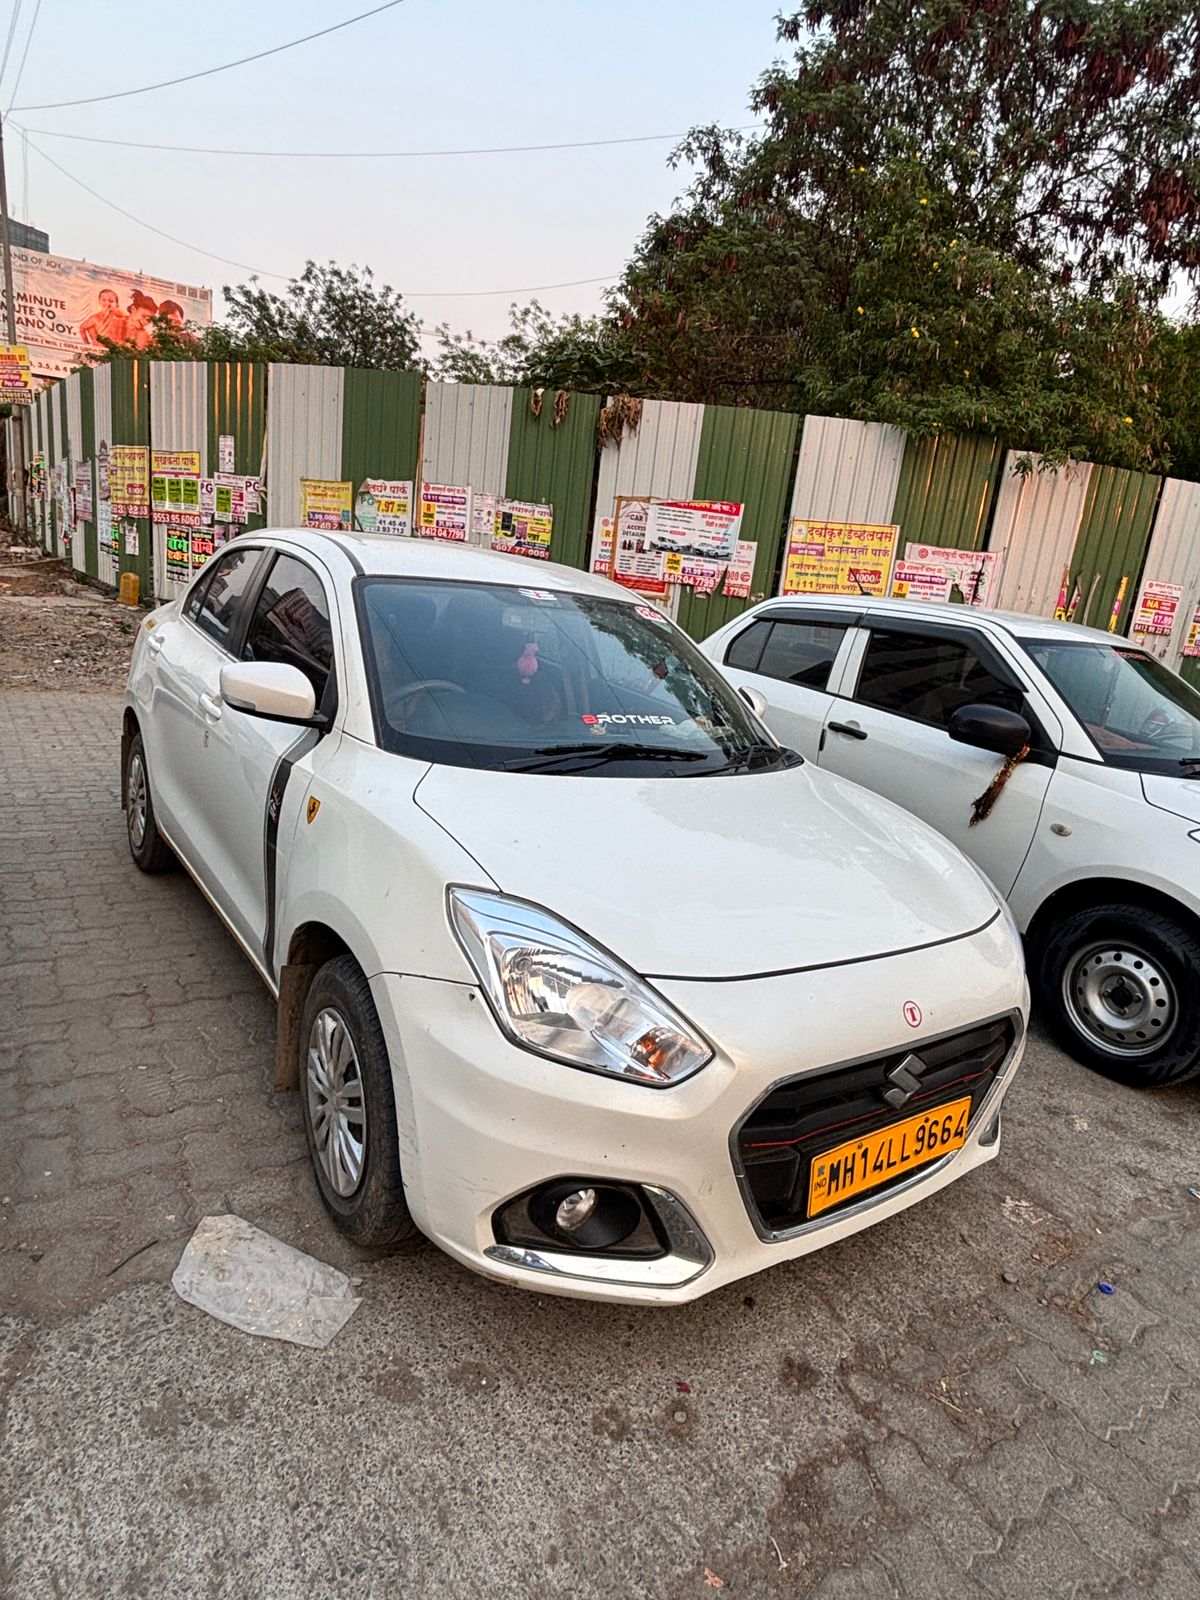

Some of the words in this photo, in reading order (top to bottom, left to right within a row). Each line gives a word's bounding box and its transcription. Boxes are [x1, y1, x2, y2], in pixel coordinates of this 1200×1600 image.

[31, 256, 43, 265] OF
[46, 258, 62, 269] JOY
[39, 308, 56, 320] TO
[17, 316, 45, 330] AND
[49, 321, 77, 336] JOY.
[246, 481, 259, 492] PG
[361, 497, 374, 505] PG
[377, 500, 395, 513] 7.97
[426, 504, 431, 512] R
[630, 514, 643, 522] CAR
[421, 527, 436, 536] 8412
[448, 530, 464, 540] 7799
[605, 530, 611, 538] R
[871, 546, 891, 557] पार्क
[595, 562, 610, 571] 841
[666, 557, 680, 566] ZONE
[664, 574, 681, 583] 8412
[683, 576, 693, 584] 04
[695, 577, 715, 587] 7799
[731, 587, 749, 596] 7799
[898, 583, 904, 592] R
[1147, 600, 1159, 609] NA
[582, 713, 675, 726] BROTHER
[906, 1006, 918, 1023] T
[814, 1177, 827, 1191] IND
